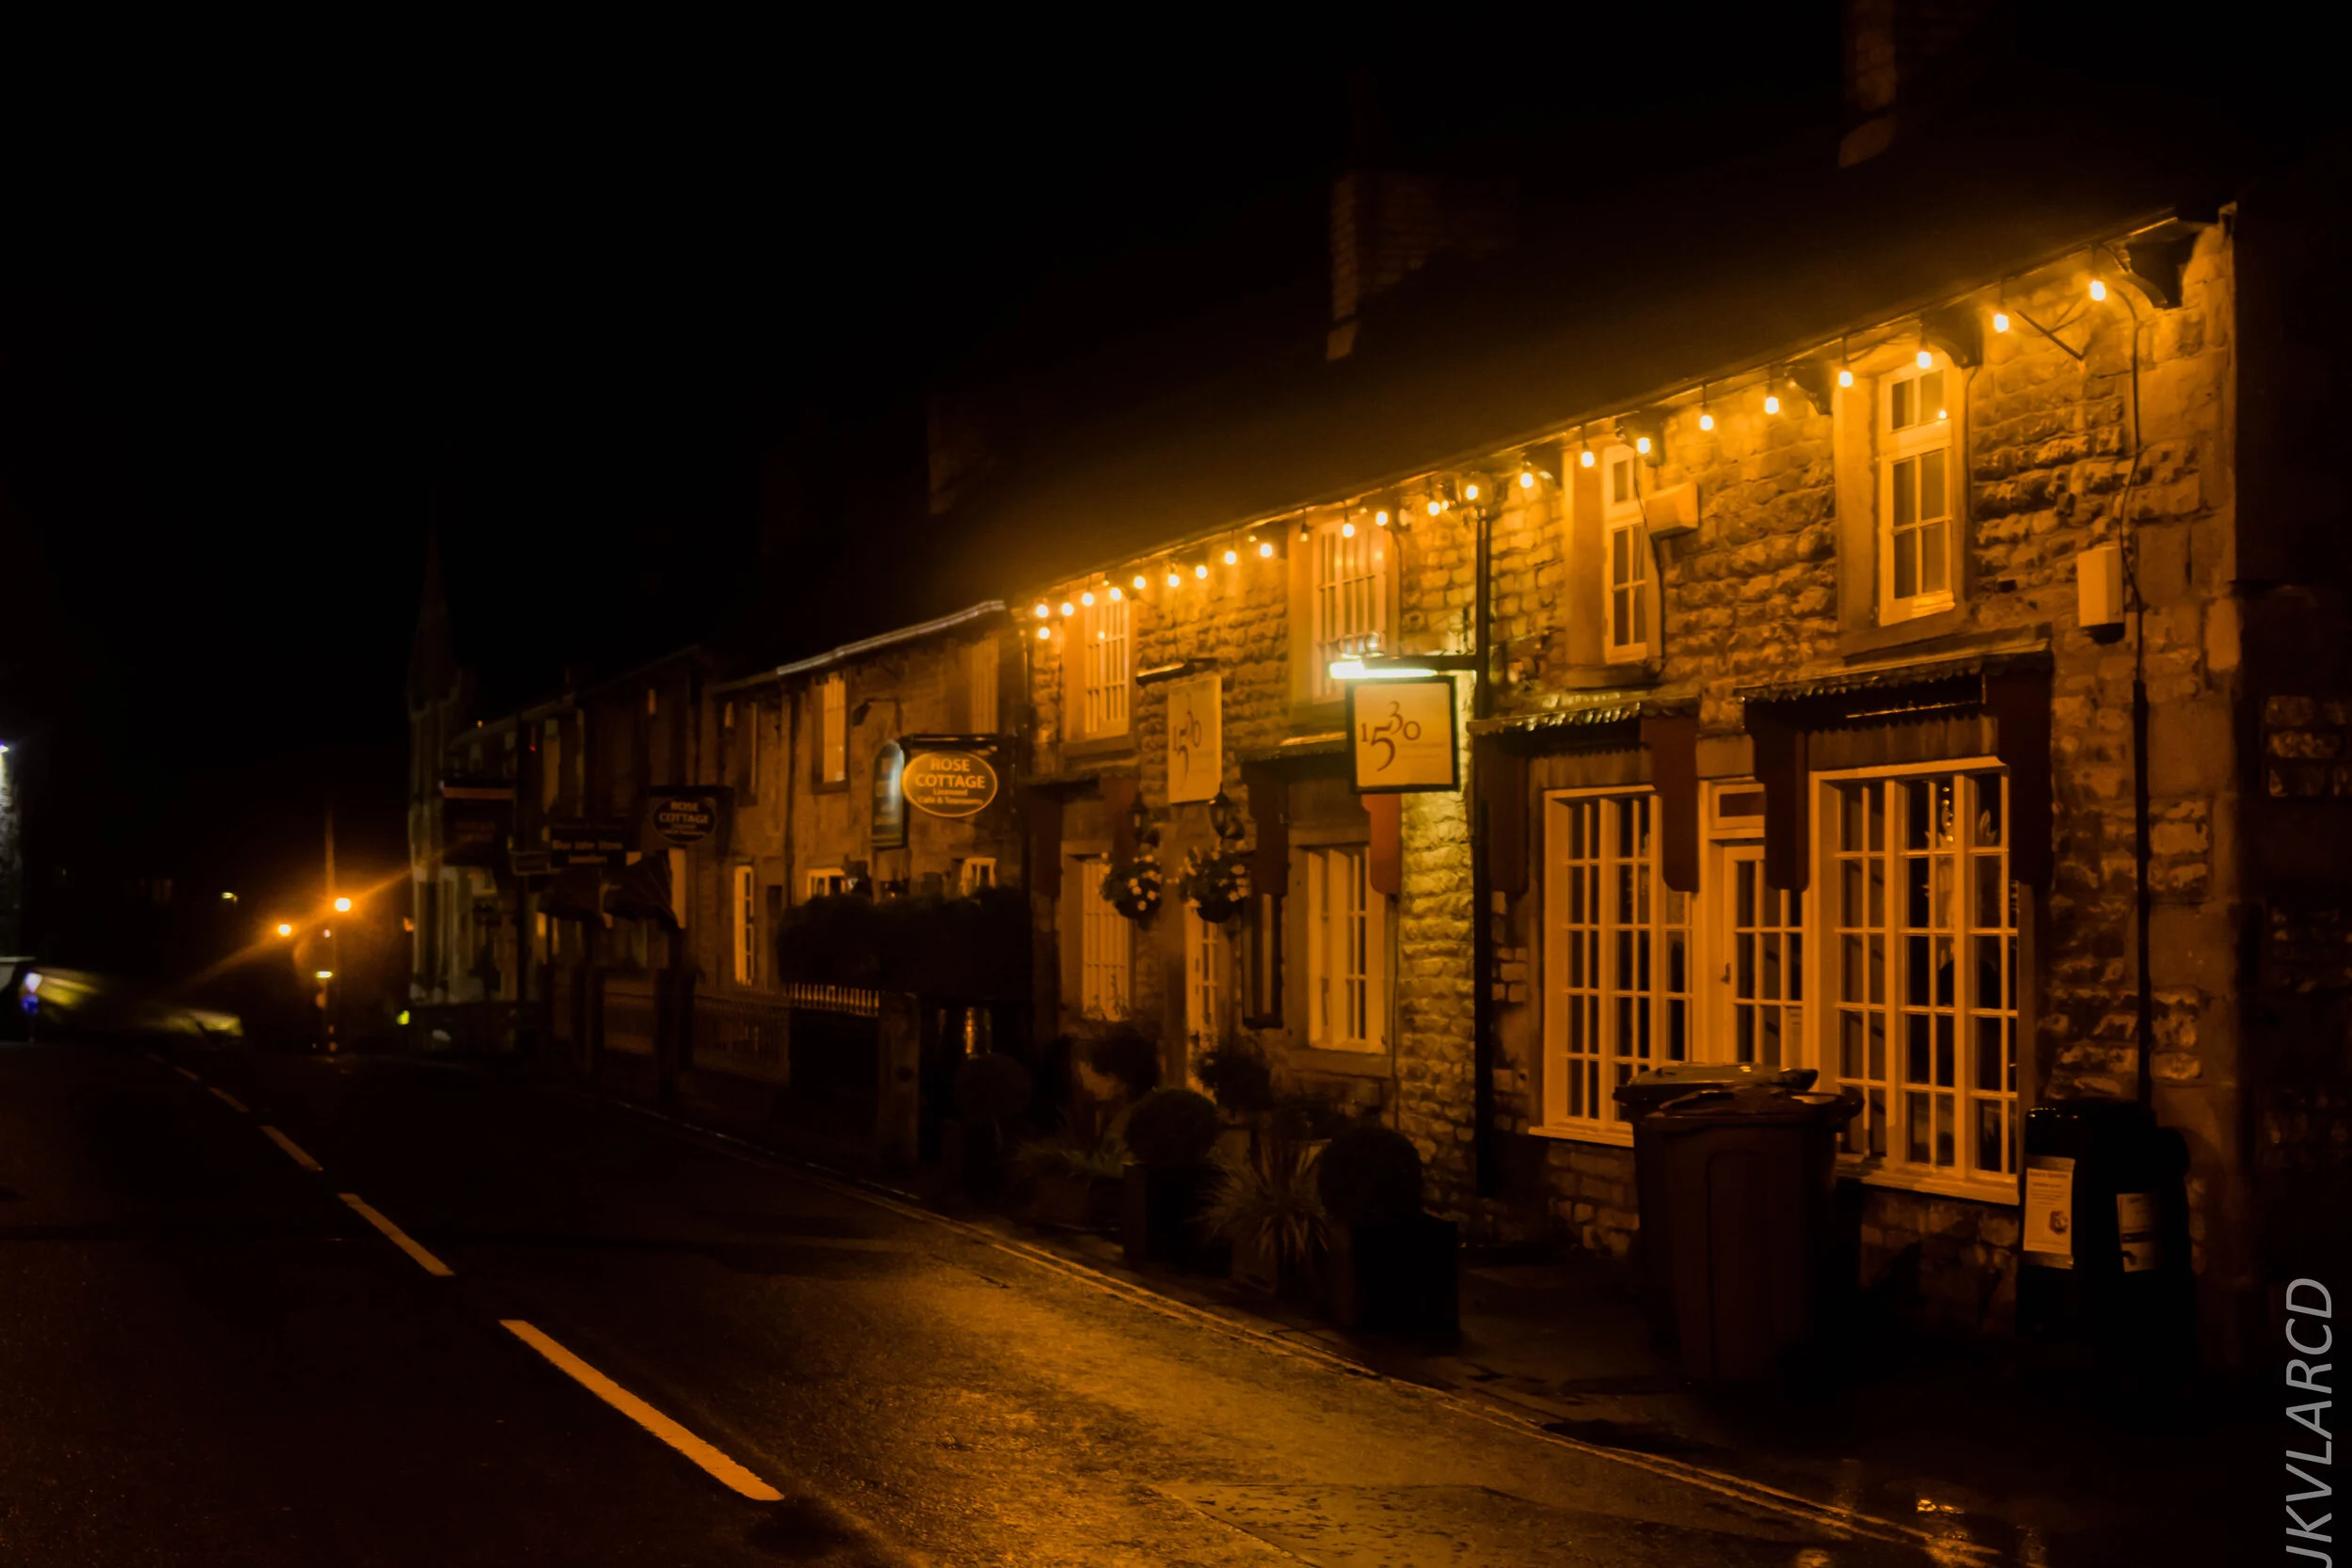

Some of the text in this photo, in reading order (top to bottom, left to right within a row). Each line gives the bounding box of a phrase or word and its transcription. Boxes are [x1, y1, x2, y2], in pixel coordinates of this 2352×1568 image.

[1361, 701, 1421, 771] 1530
[931, 758, 970, 771] ROSE
[915, 774, 986, 788] COTTAGE
[672, 801, 698, 811] ROSE
[660, 813, 708, 824] COTTAGE
